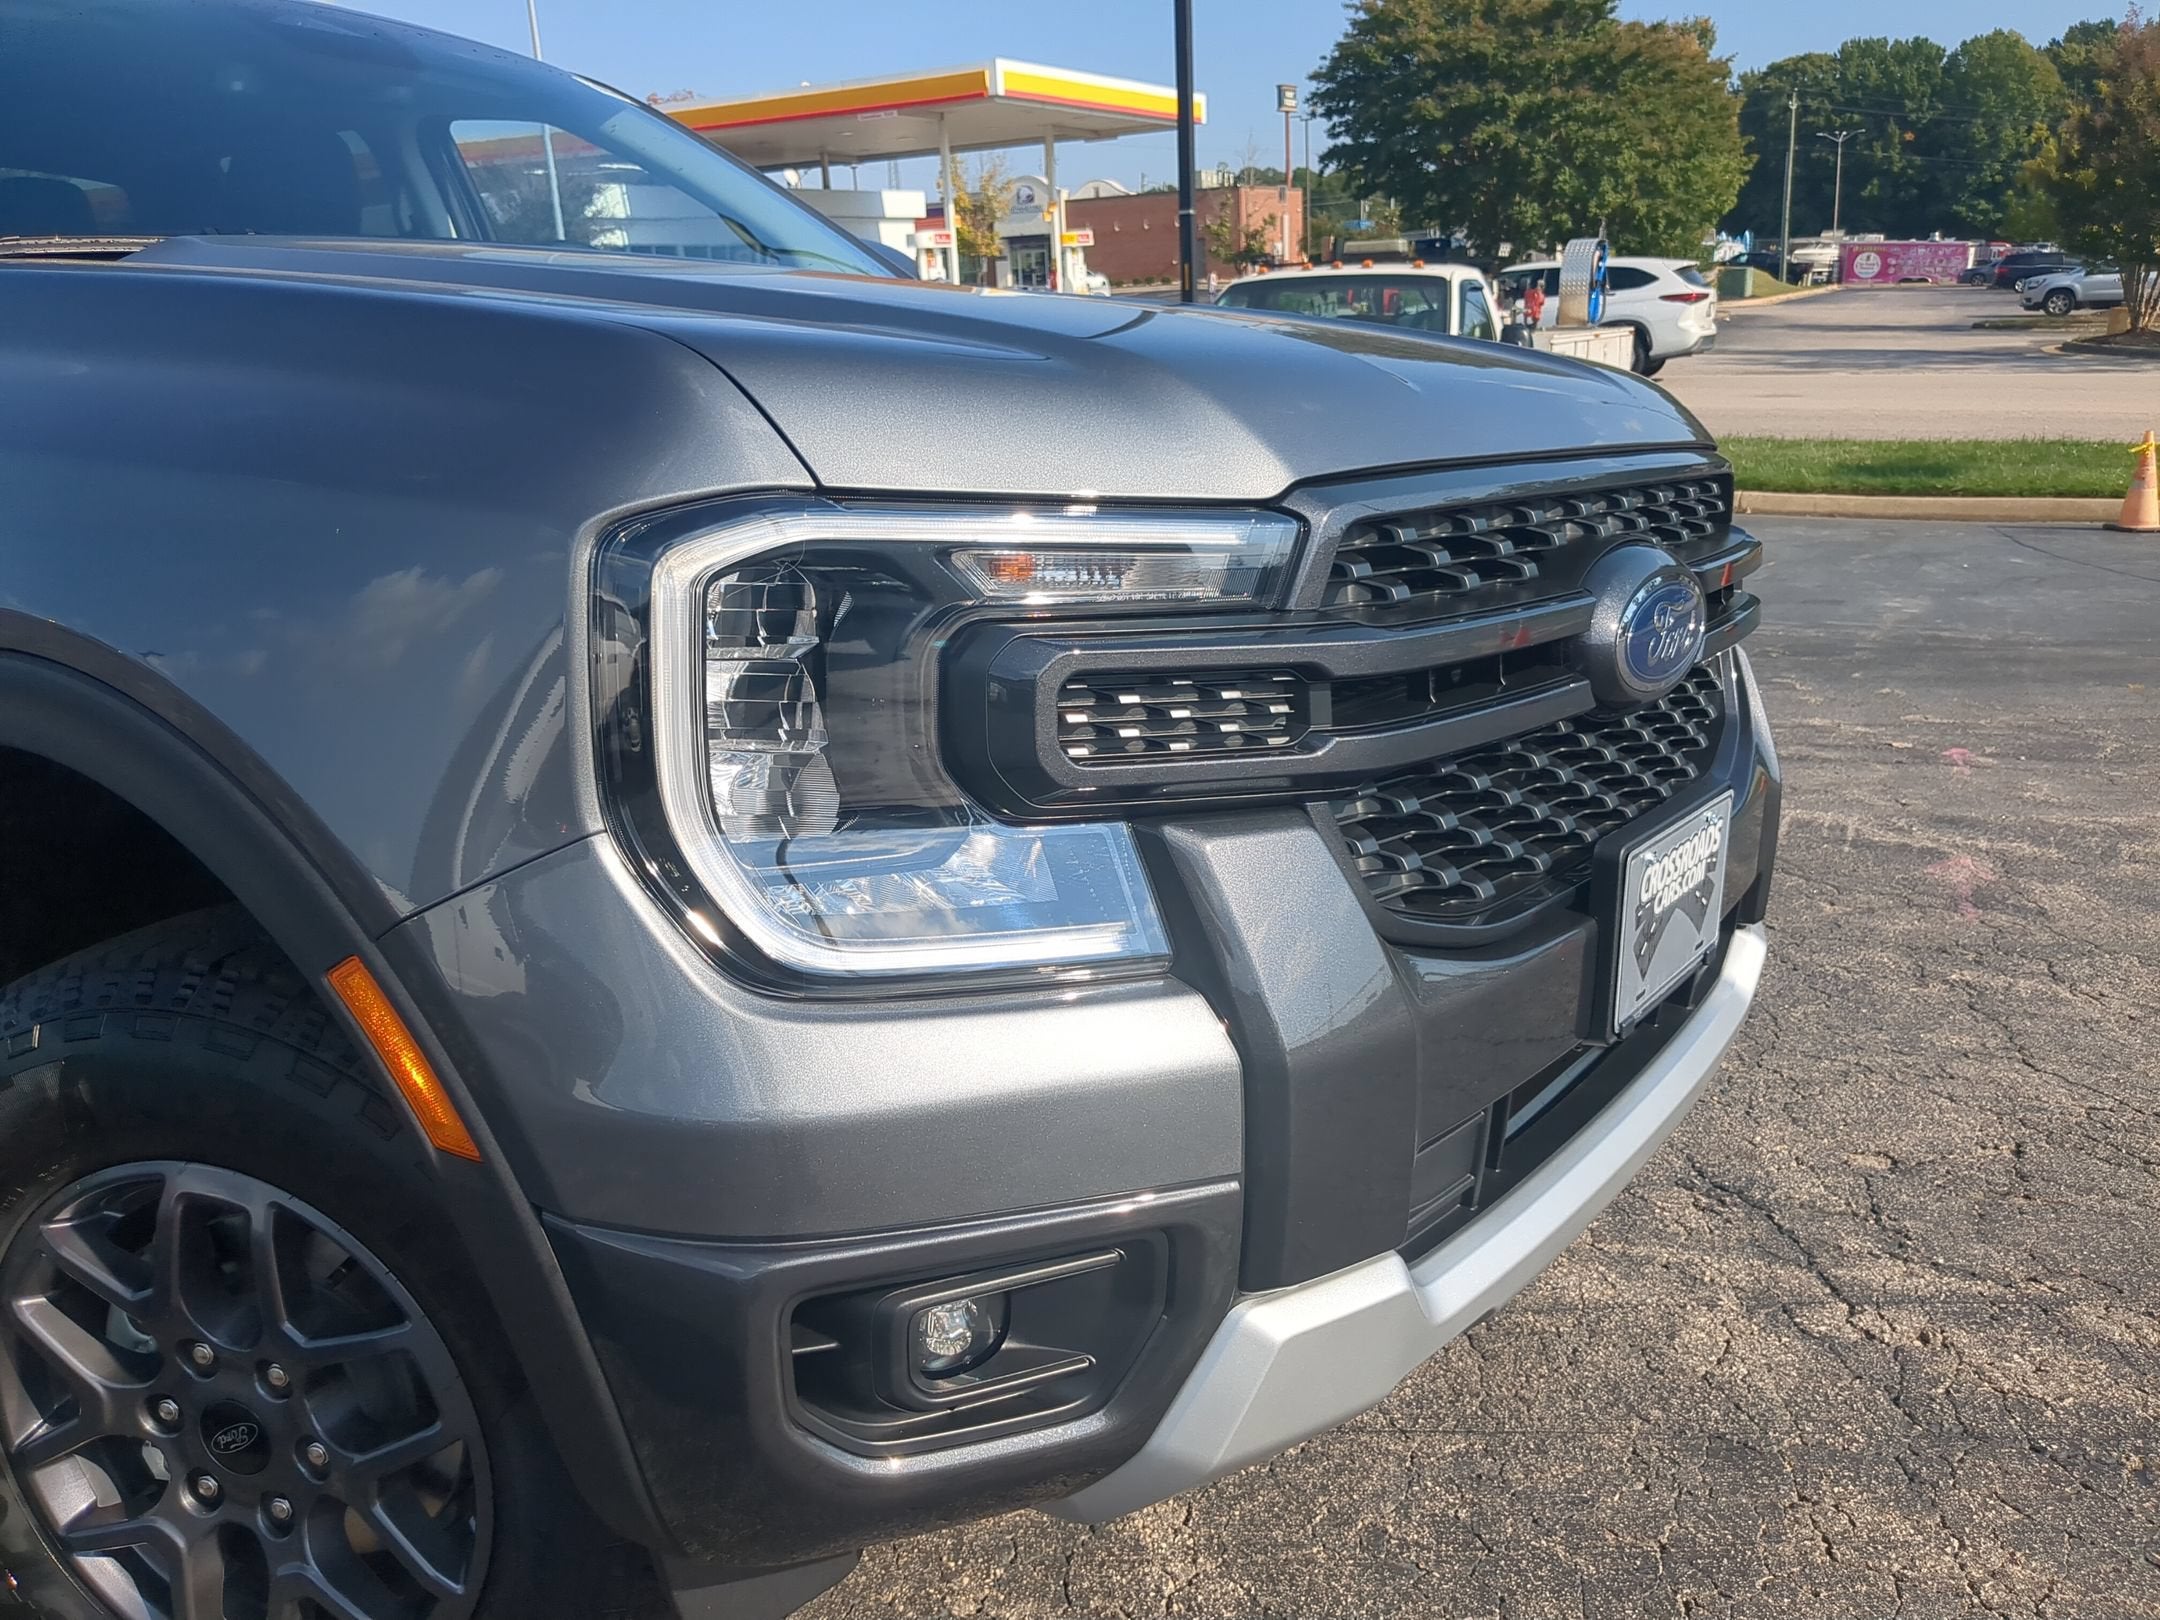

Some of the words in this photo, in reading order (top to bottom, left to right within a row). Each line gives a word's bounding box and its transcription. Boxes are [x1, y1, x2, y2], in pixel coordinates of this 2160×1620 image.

[1647, 599, 1697, 667] Ford
[1641, 820, 1723, 903] CROSSROADS
[1654, 859, 1706, 914] CARS.COM
[217, 1426, 248, 1449] Ford
